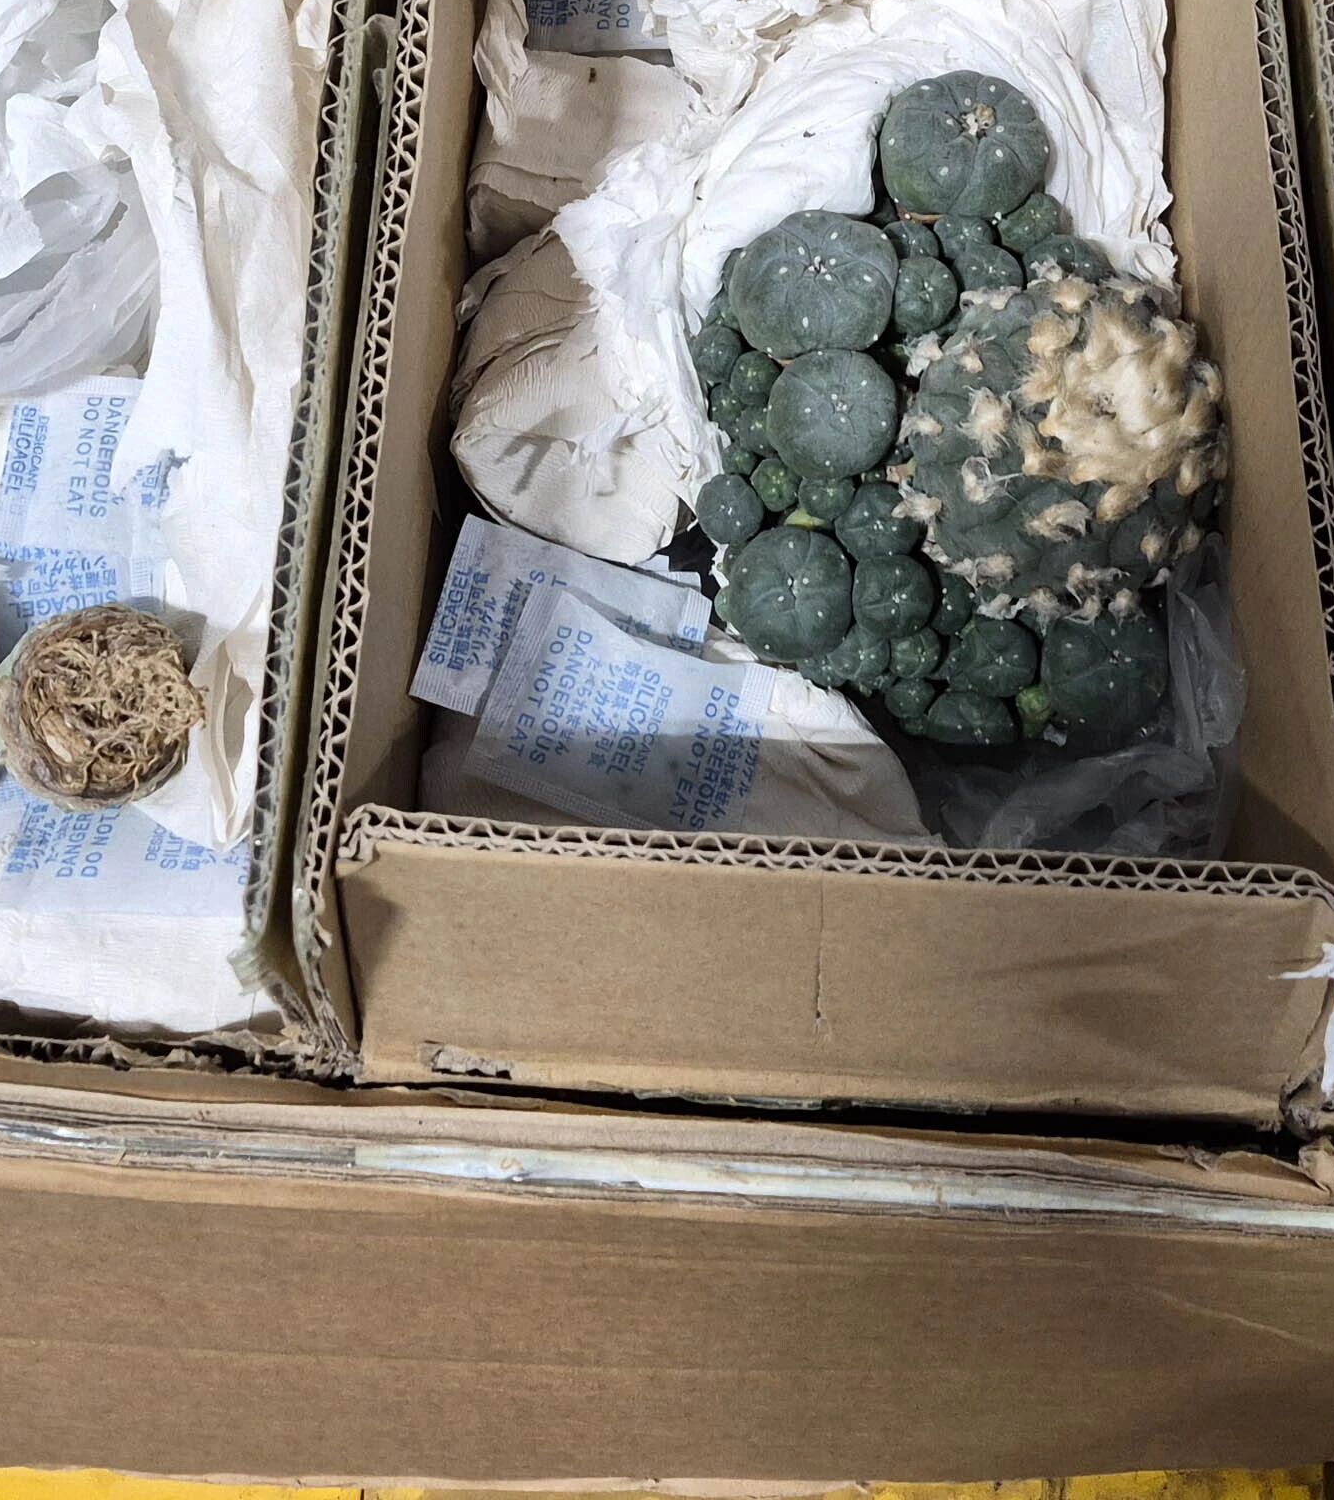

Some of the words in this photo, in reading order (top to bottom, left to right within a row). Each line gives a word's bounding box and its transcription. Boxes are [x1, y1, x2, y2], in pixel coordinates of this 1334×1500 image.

[616, 3, 631, 29] DO
[83, 396, 103, 421] DO
[5, 407, 36, 495] SILICAGEL
[25, 415, 50, 492] DESICCANT
[74, 428, 96, 468] NOT
[89, 397, 126, 518] DANGEROUS
[67, 476, 87, 516] EAT
[429, 567, 472, 665] SILICAGEL
[550, 626, 572, 654] DO
[528, 661, 556, 709] NOT
[529, 630, 593, 765] DANGEROUS
[705, 686, 724, 718] DO
[507, 713, 535, 757] EAT
[606, 669, 660, 775] SILICAGEL
[631, 685, 673, 775] DESICCANT
[687, 723, 710, 775] NOT
[689, 694, 740, 830] DANGEROUS
[669, 777, 694, 823] EAT
[81, 851, 103, 878] DO
[96, 812, 119, 846] NOT
